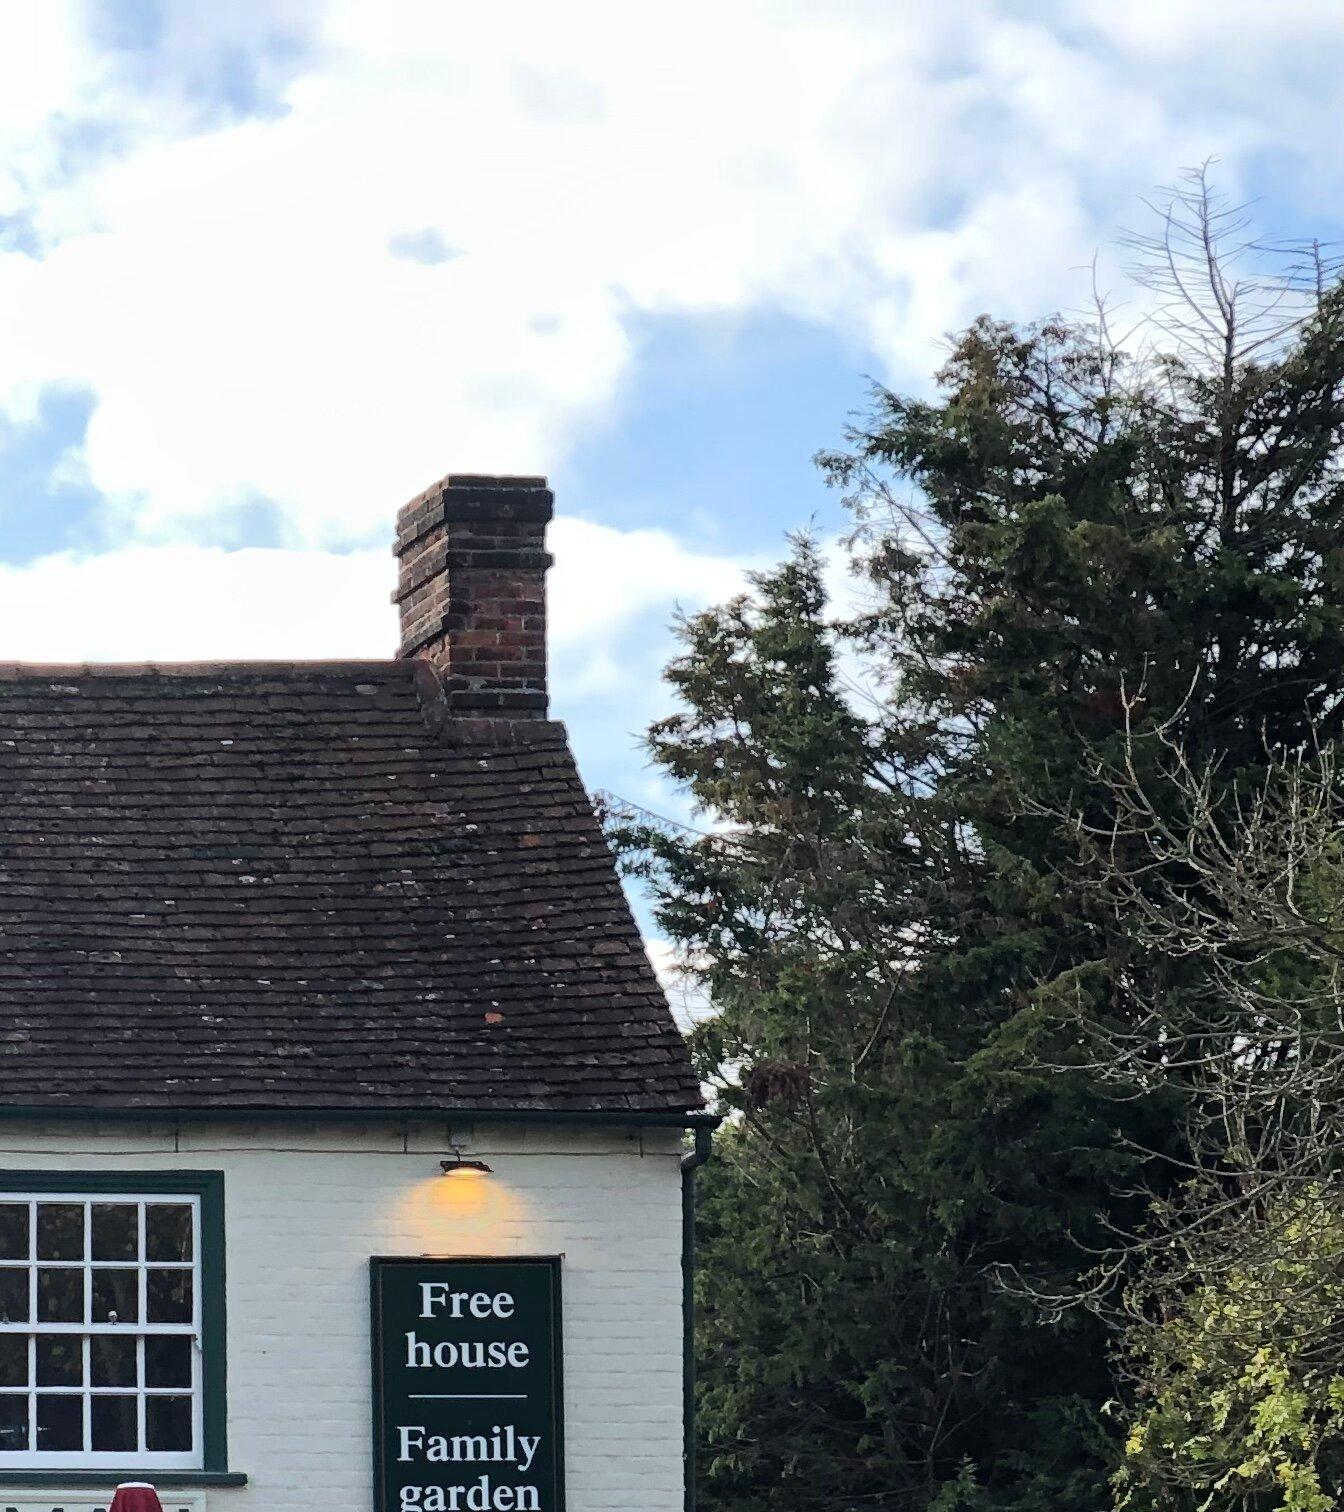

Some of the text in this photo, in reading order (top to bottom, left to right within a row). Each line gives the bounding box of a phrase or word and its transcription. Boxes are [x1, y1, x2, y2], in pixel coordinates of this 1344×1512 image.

[417, 1281, 515, 1319] Free
[404, 1330, 530, 1369] house
[395, 1424, 542, 1473] Family
